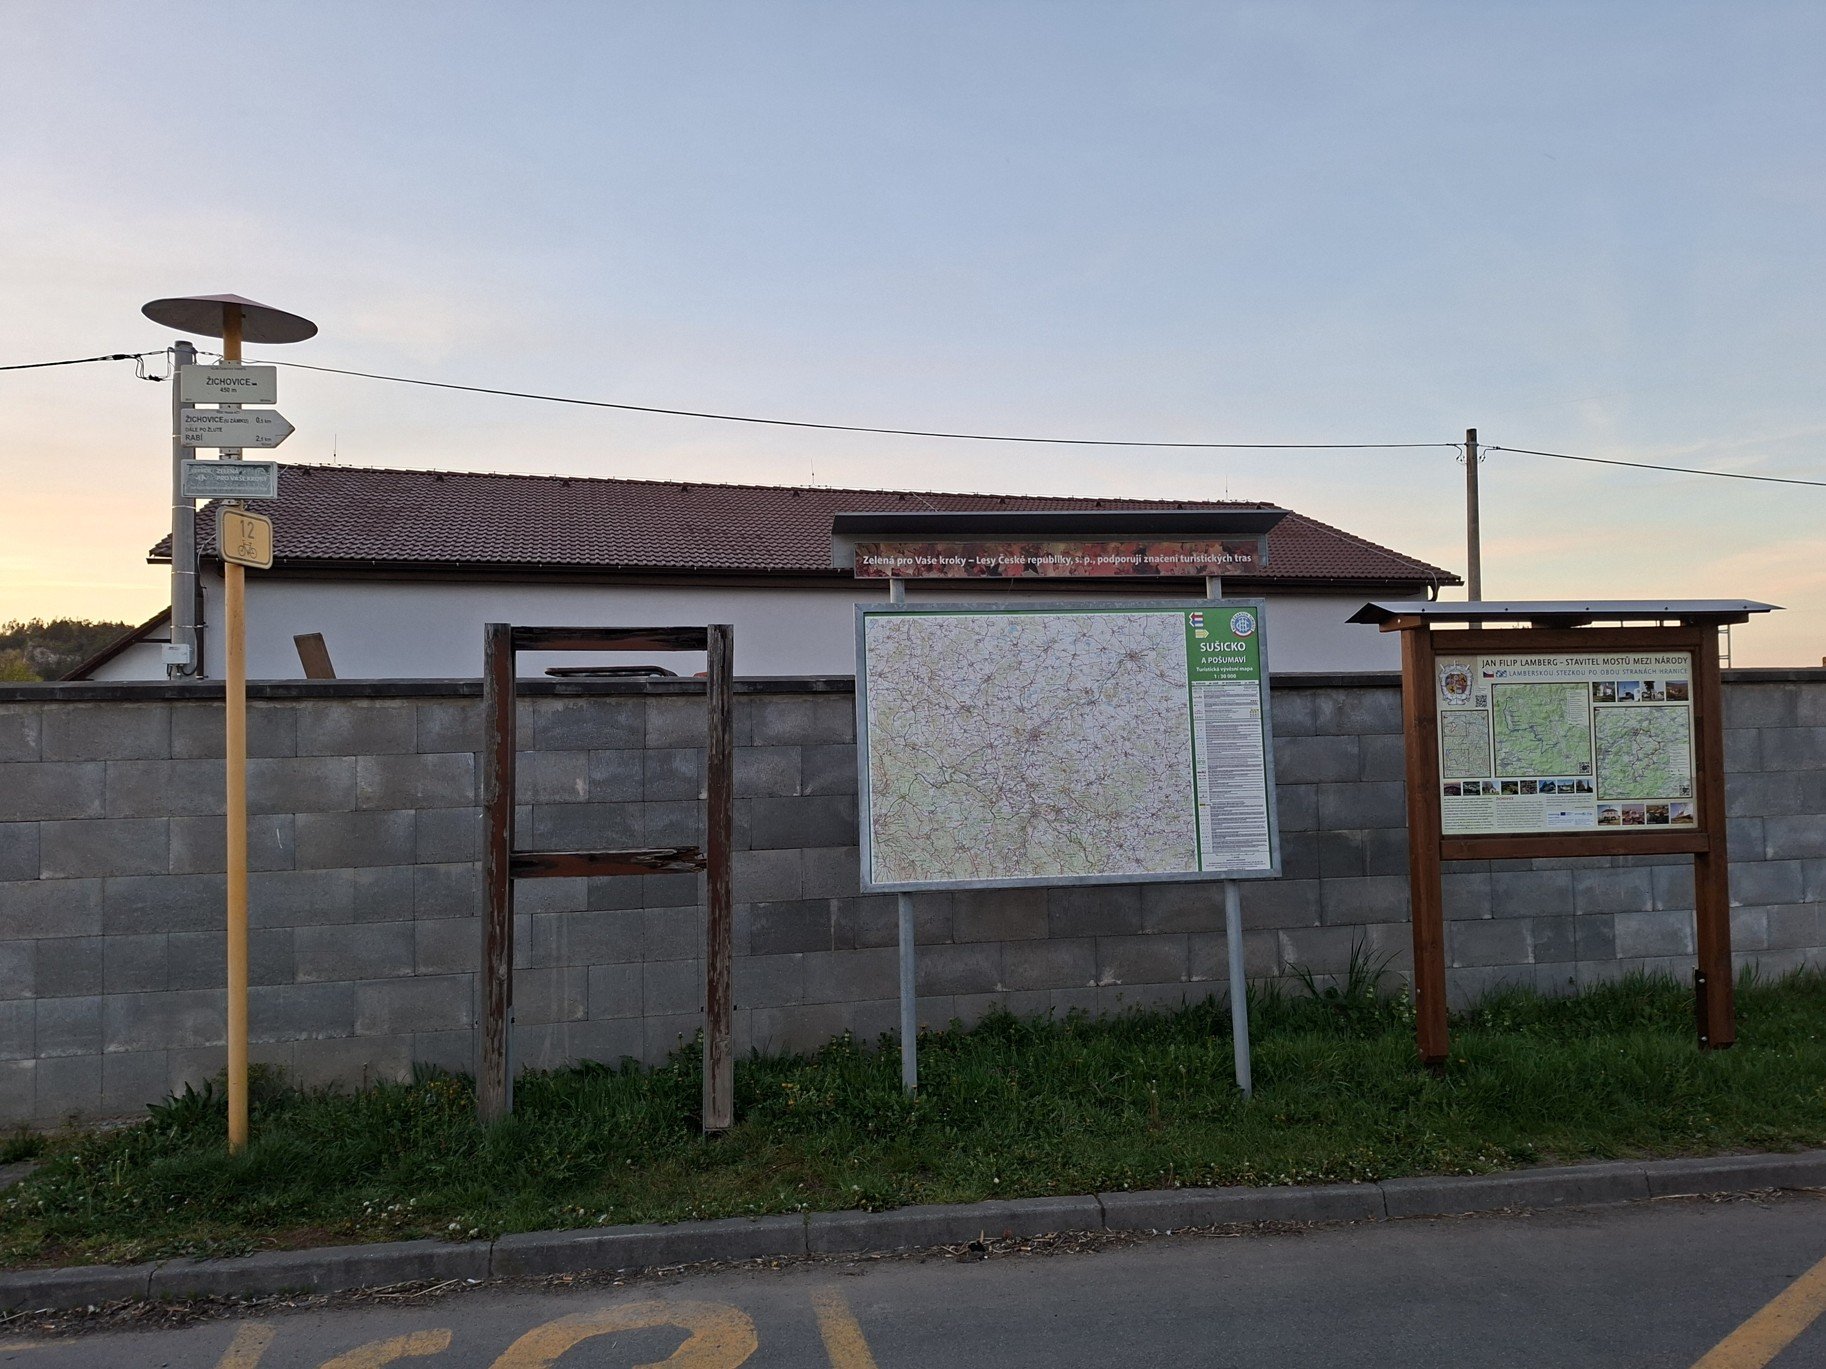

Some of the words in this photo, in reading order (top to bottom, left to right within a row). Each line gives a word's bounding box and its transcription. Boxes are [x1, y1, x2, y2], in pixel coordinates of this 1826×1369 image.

[206, 376, 251, 386] ŽICHOVICE
[185, 415, 224, 423] ŽICHOVICE
[240, 520, 254, 539] 12
[863, 555, 895, 564] Zelená
[897, 558, 913, 566] pro
[914, 555, 938, 564] Vaše
[940, 555, 966, 566] kroky
[976, 556, 996, 566] Lesy
[998, 554, 1026, 564] České
[1028, 555, 1074, 566] republiky,
[1144, 554, 1179, 563] značení
[1180, 554, 1233, 564] turistických
[1234, 554, 1252, 562] tras
[1200, 640, 1246, 652] SUŠICKO
[1208, 656, 1246, 664] POŠUMAVÍ
[1482, 660, 1496, 668] JAN
[1520, 658, 1558, 666] LAMBERG
[1566, 658, 1600, 666] STAVITEL
[1602, 656, 1630, 666] MOSTŮ
[1633, 657, 1652, 665] MEZI
[1654, 656, 1688, 665] NÁRODY
[1622, 667, 1656, 675] STRANÁCH
